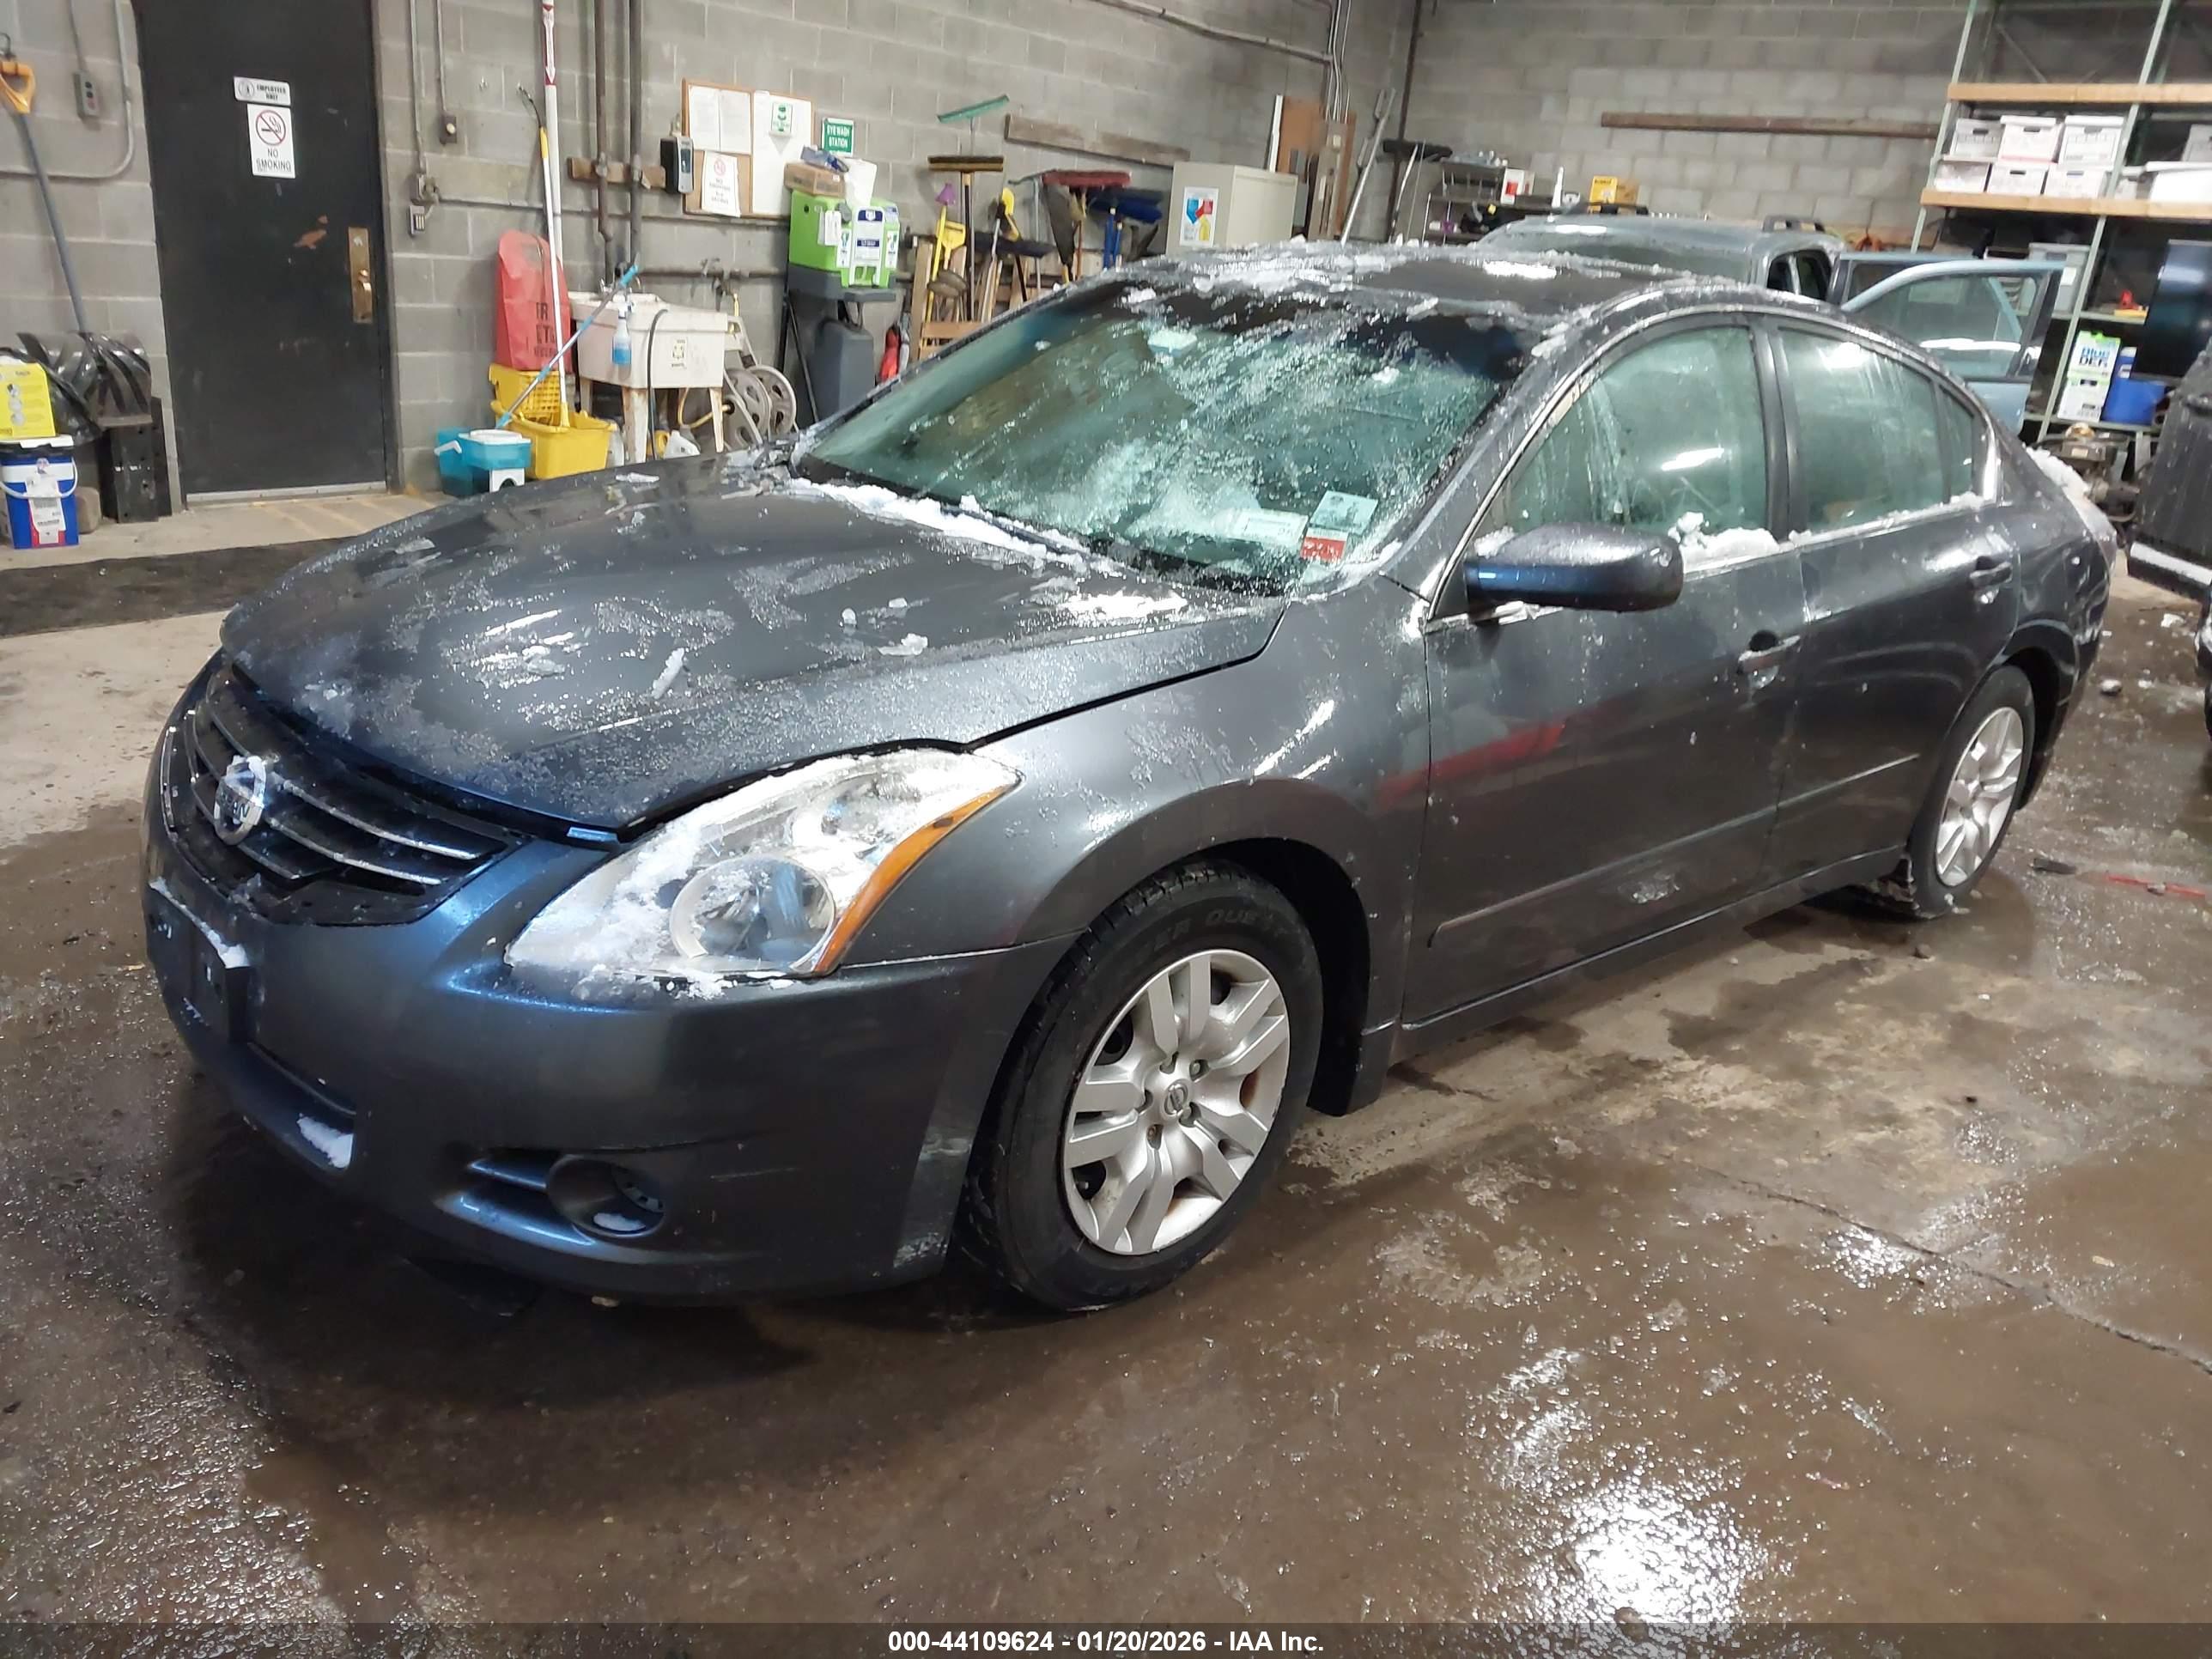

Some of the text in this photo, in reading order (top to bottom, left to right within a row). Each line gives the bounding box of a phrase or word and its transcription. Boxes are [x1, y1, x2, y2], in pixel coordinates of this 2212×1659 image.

[829, 136, 848, 148] STATION
[267, 147, 278, 158] NO
[256, 158, 291, 172] SMOKING
